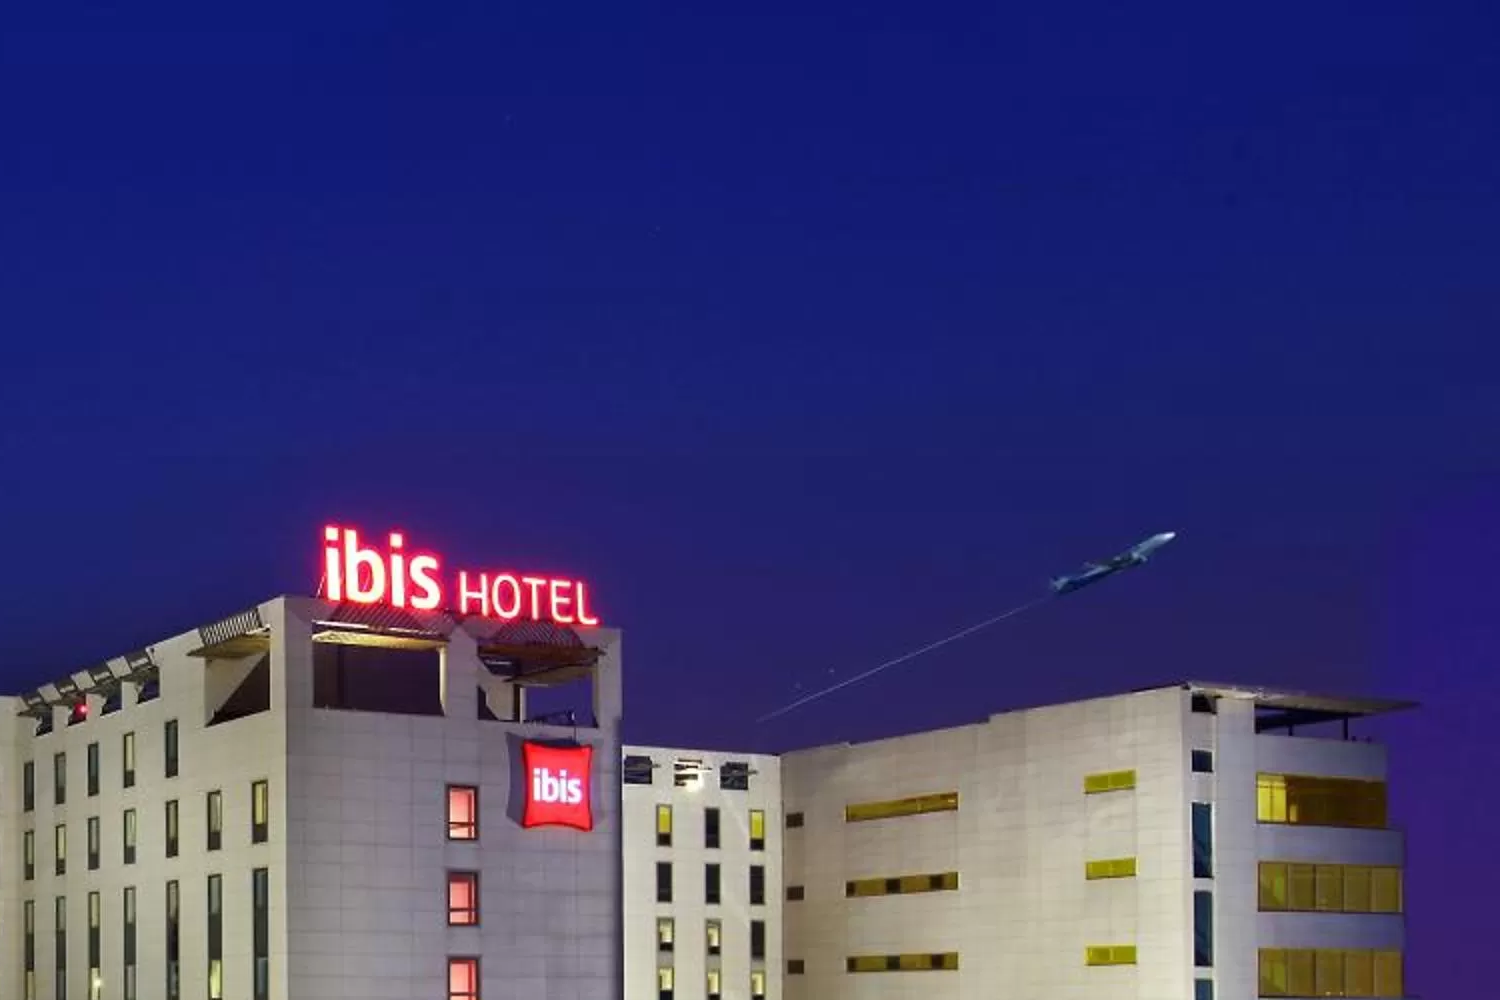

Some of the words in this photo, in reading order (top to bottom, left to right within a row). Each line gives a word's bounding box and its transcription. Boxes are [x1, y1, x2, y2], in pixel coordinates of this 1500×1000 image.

[325, 526, 441, 609] ibis
[459, 572, 599, 625] HOTEL
[532, 767, 583, 805] ibis
